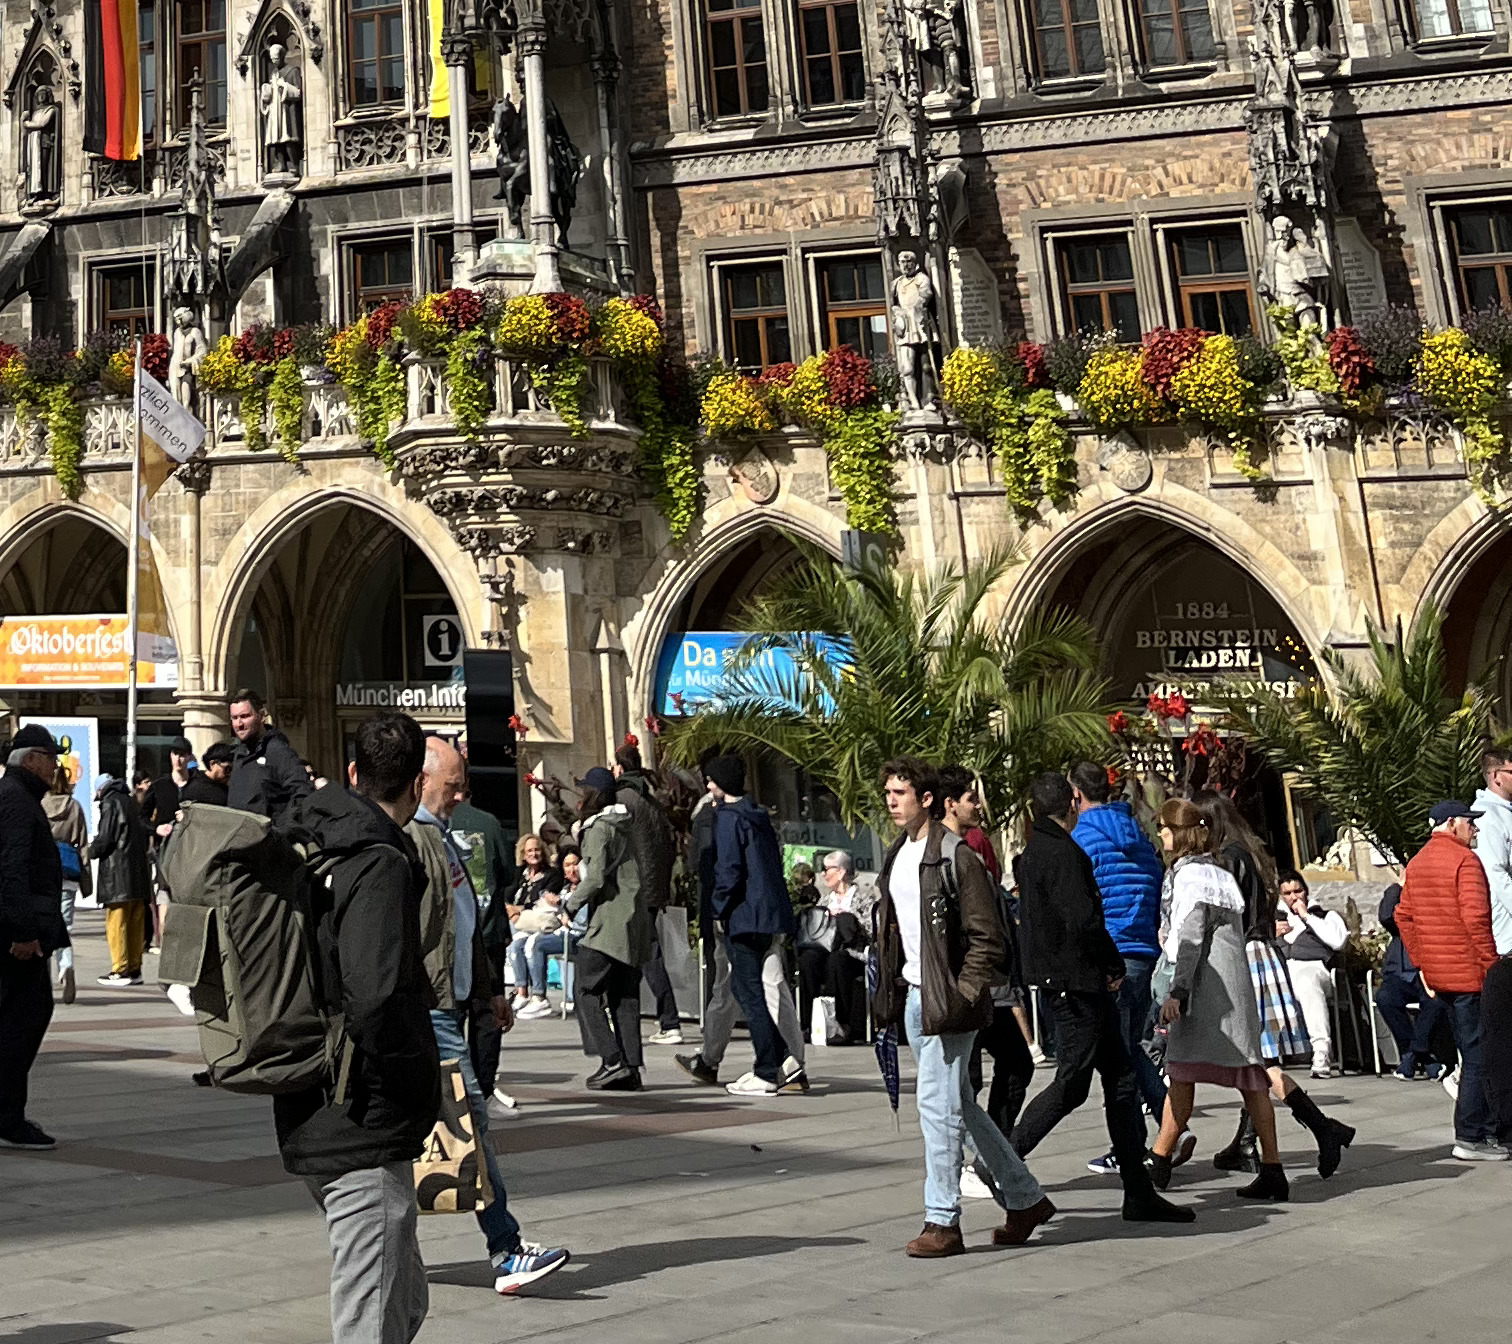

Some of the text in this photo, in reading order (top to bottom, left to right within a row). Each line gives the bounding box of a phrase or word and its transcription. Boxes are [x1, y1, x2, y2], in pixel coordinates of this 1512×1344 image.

[1175, 602, 1230, 619] 1884
[7, 624, 135, 658] Oktoberfest
[1136, 628, 1278, 648] BERNSTEIN
[683, 640, 717, 667] Da
[1168, 649, 1251, 668] LADEN
[336, 683, 426, 707] München
